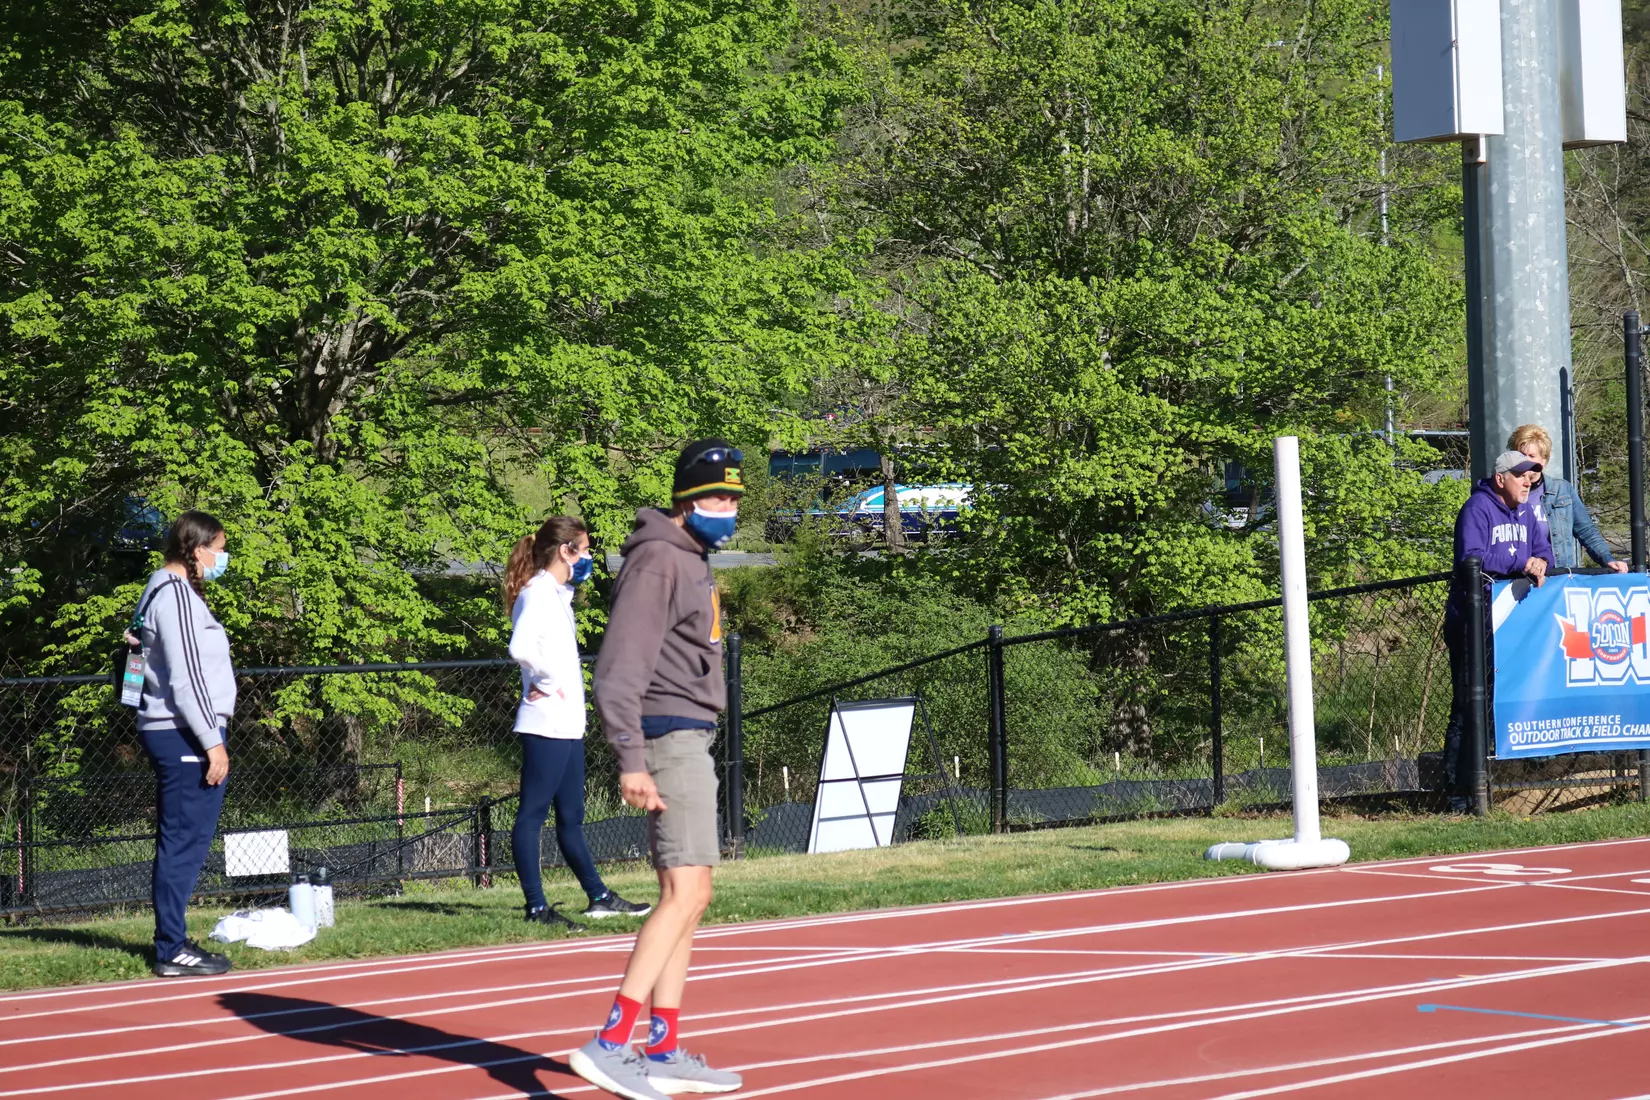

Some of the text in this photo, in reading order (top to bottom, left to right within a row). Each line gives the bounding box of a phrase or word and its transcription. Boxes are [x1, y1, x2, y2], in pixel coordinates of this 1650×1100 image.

[1592, 621, 1630, 648] SOCON
[1508, 715, 1621, 733] SOUTHERN CONFERENCE
[1509, 730, 1560, 744] OUTDOOR
[1560, 726, 1583, 739] TRACK
[1583, 726, 1590, 737] &
[1592, 724, 1620, 737] FIELD
